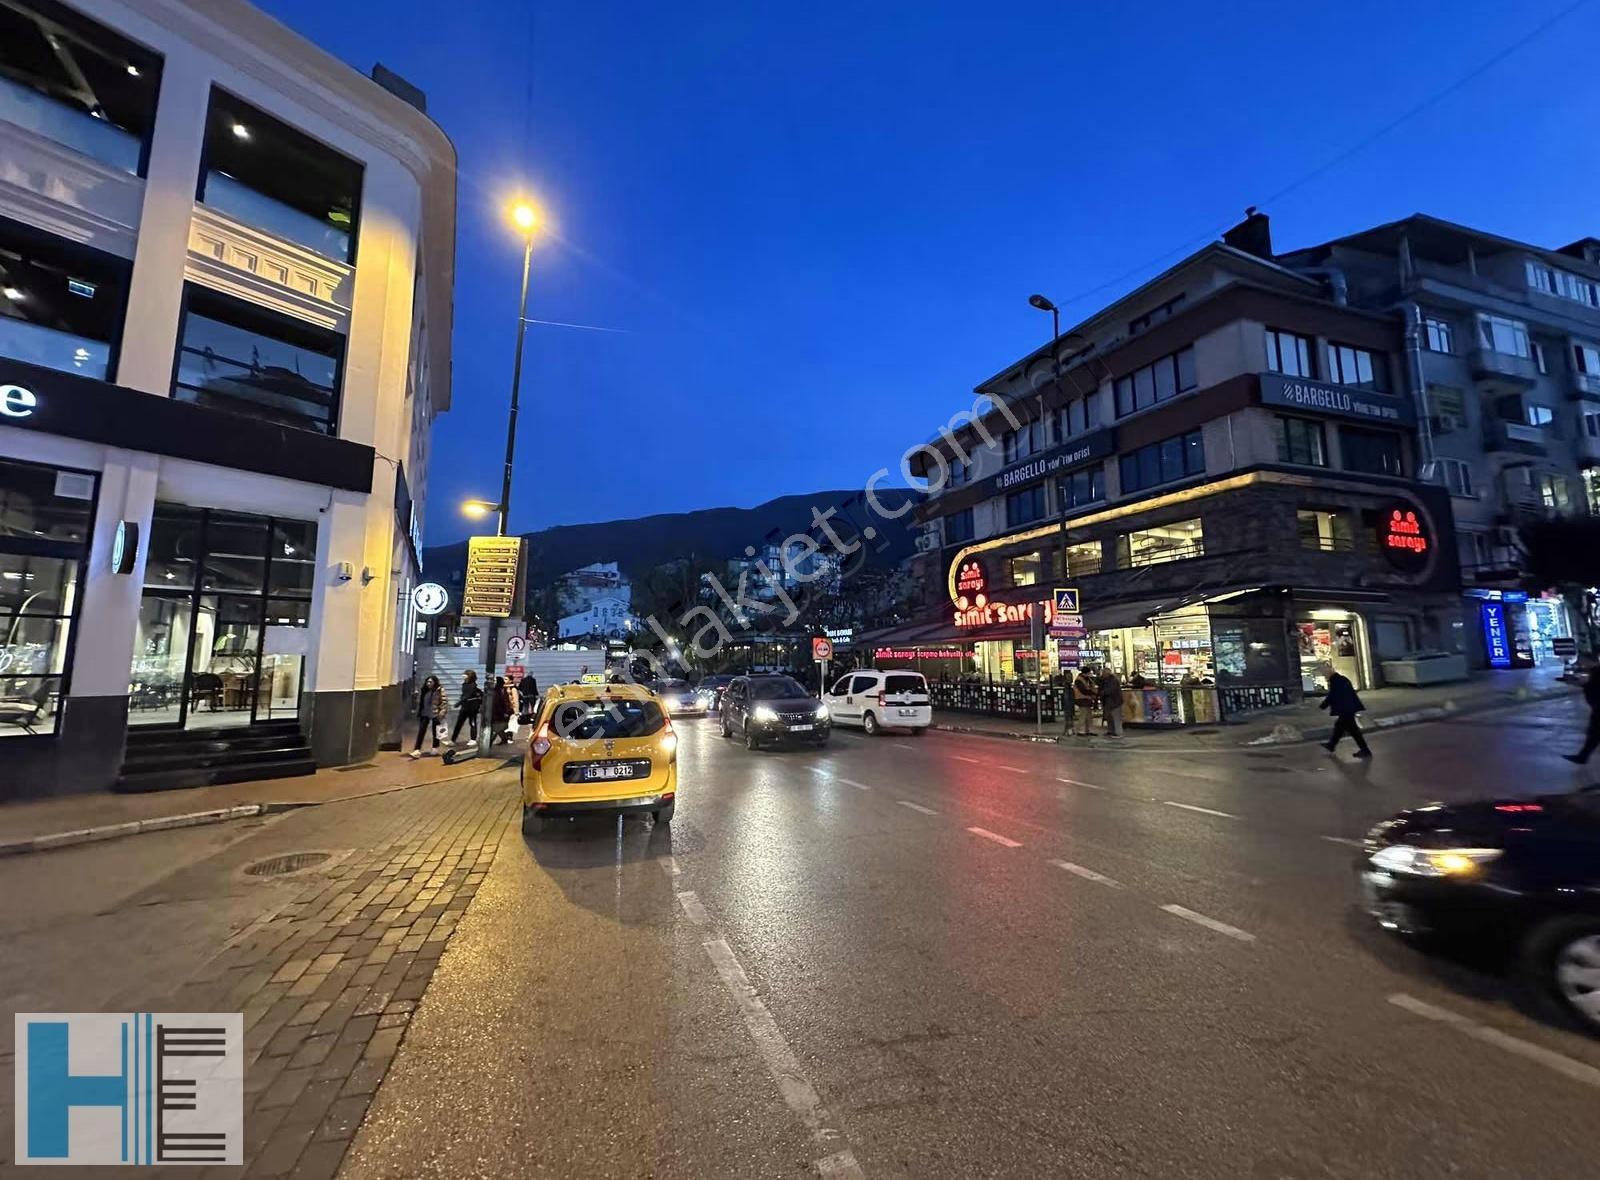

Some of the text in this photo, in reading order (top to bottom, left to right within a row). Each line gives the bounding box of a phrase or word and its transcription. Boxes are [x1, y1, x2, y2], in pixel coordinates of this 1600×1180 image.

[1295, 384, 1352, 411] BARGELLO
[1003, 459, 1046, 487] BARGELLO
[954, 604, 993, 627] simit
[1487, 607, 1505, 658] YENER
[613, 766, 633, 776] 0212
